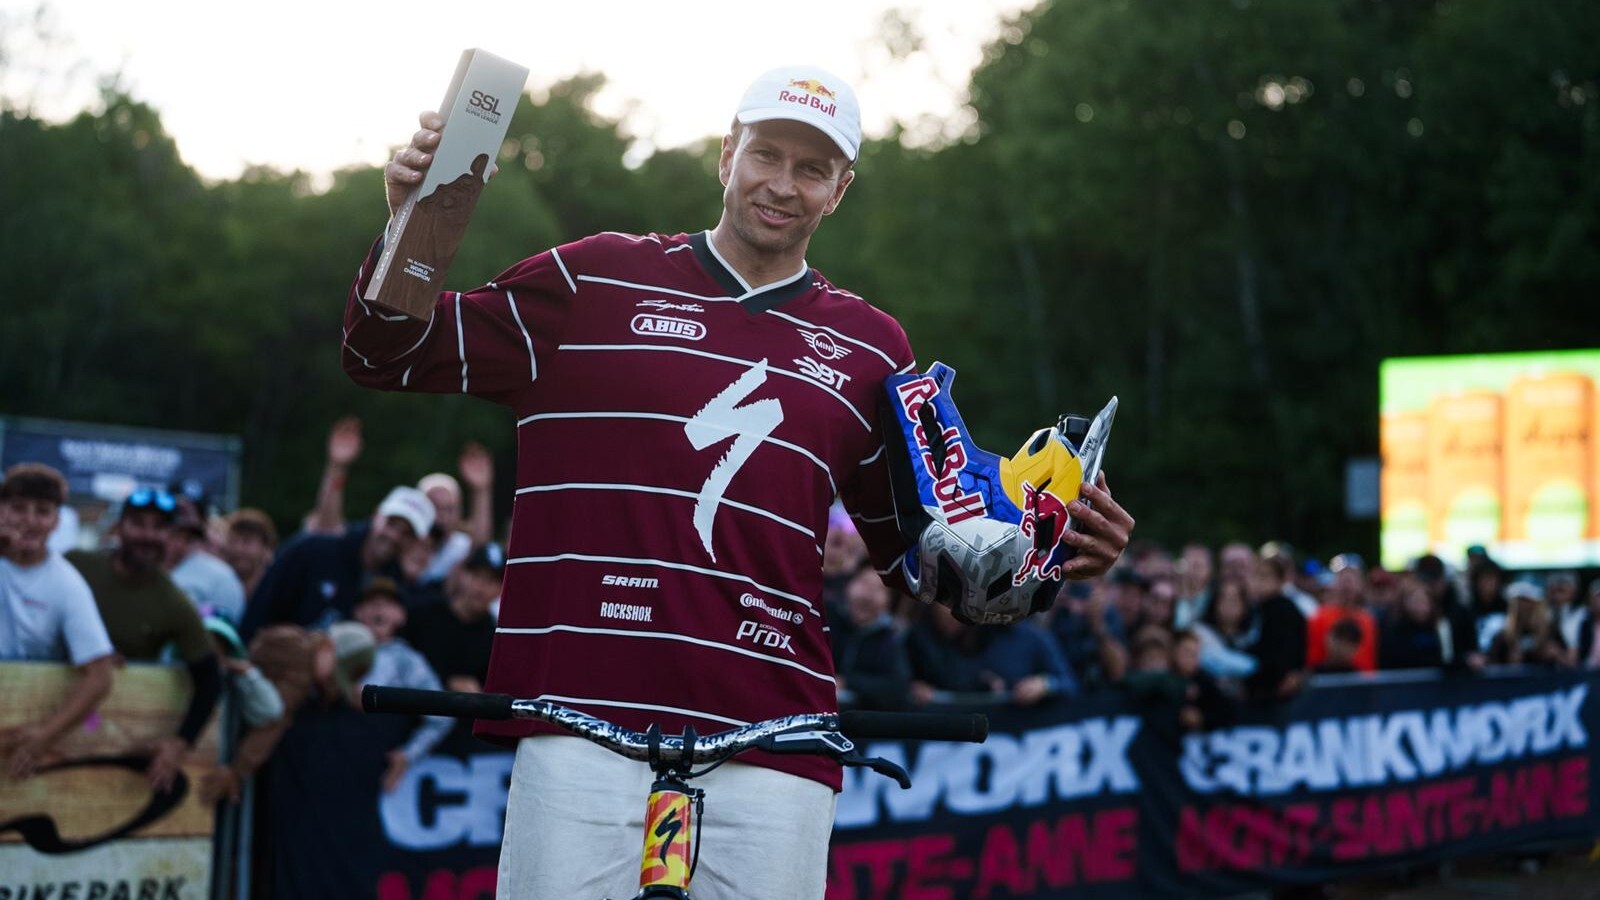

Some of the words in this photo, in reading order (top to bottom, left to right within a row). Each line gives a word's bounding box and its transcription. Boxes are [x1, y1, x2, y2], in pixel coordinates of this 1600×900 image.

[469, 89, 501, 117] SSL
[778, 90, 810, 106] Red
[810, 96, 837, 118] Bull
[638, 318, 697, 337] ABUS
[815, 340, 834, 353] MINI
[601, 574, 659, 588] SRAM
[600, 601, 652, 622] ROCKSHOX
[1178, 683, 1590, 797] CRANKWORX
